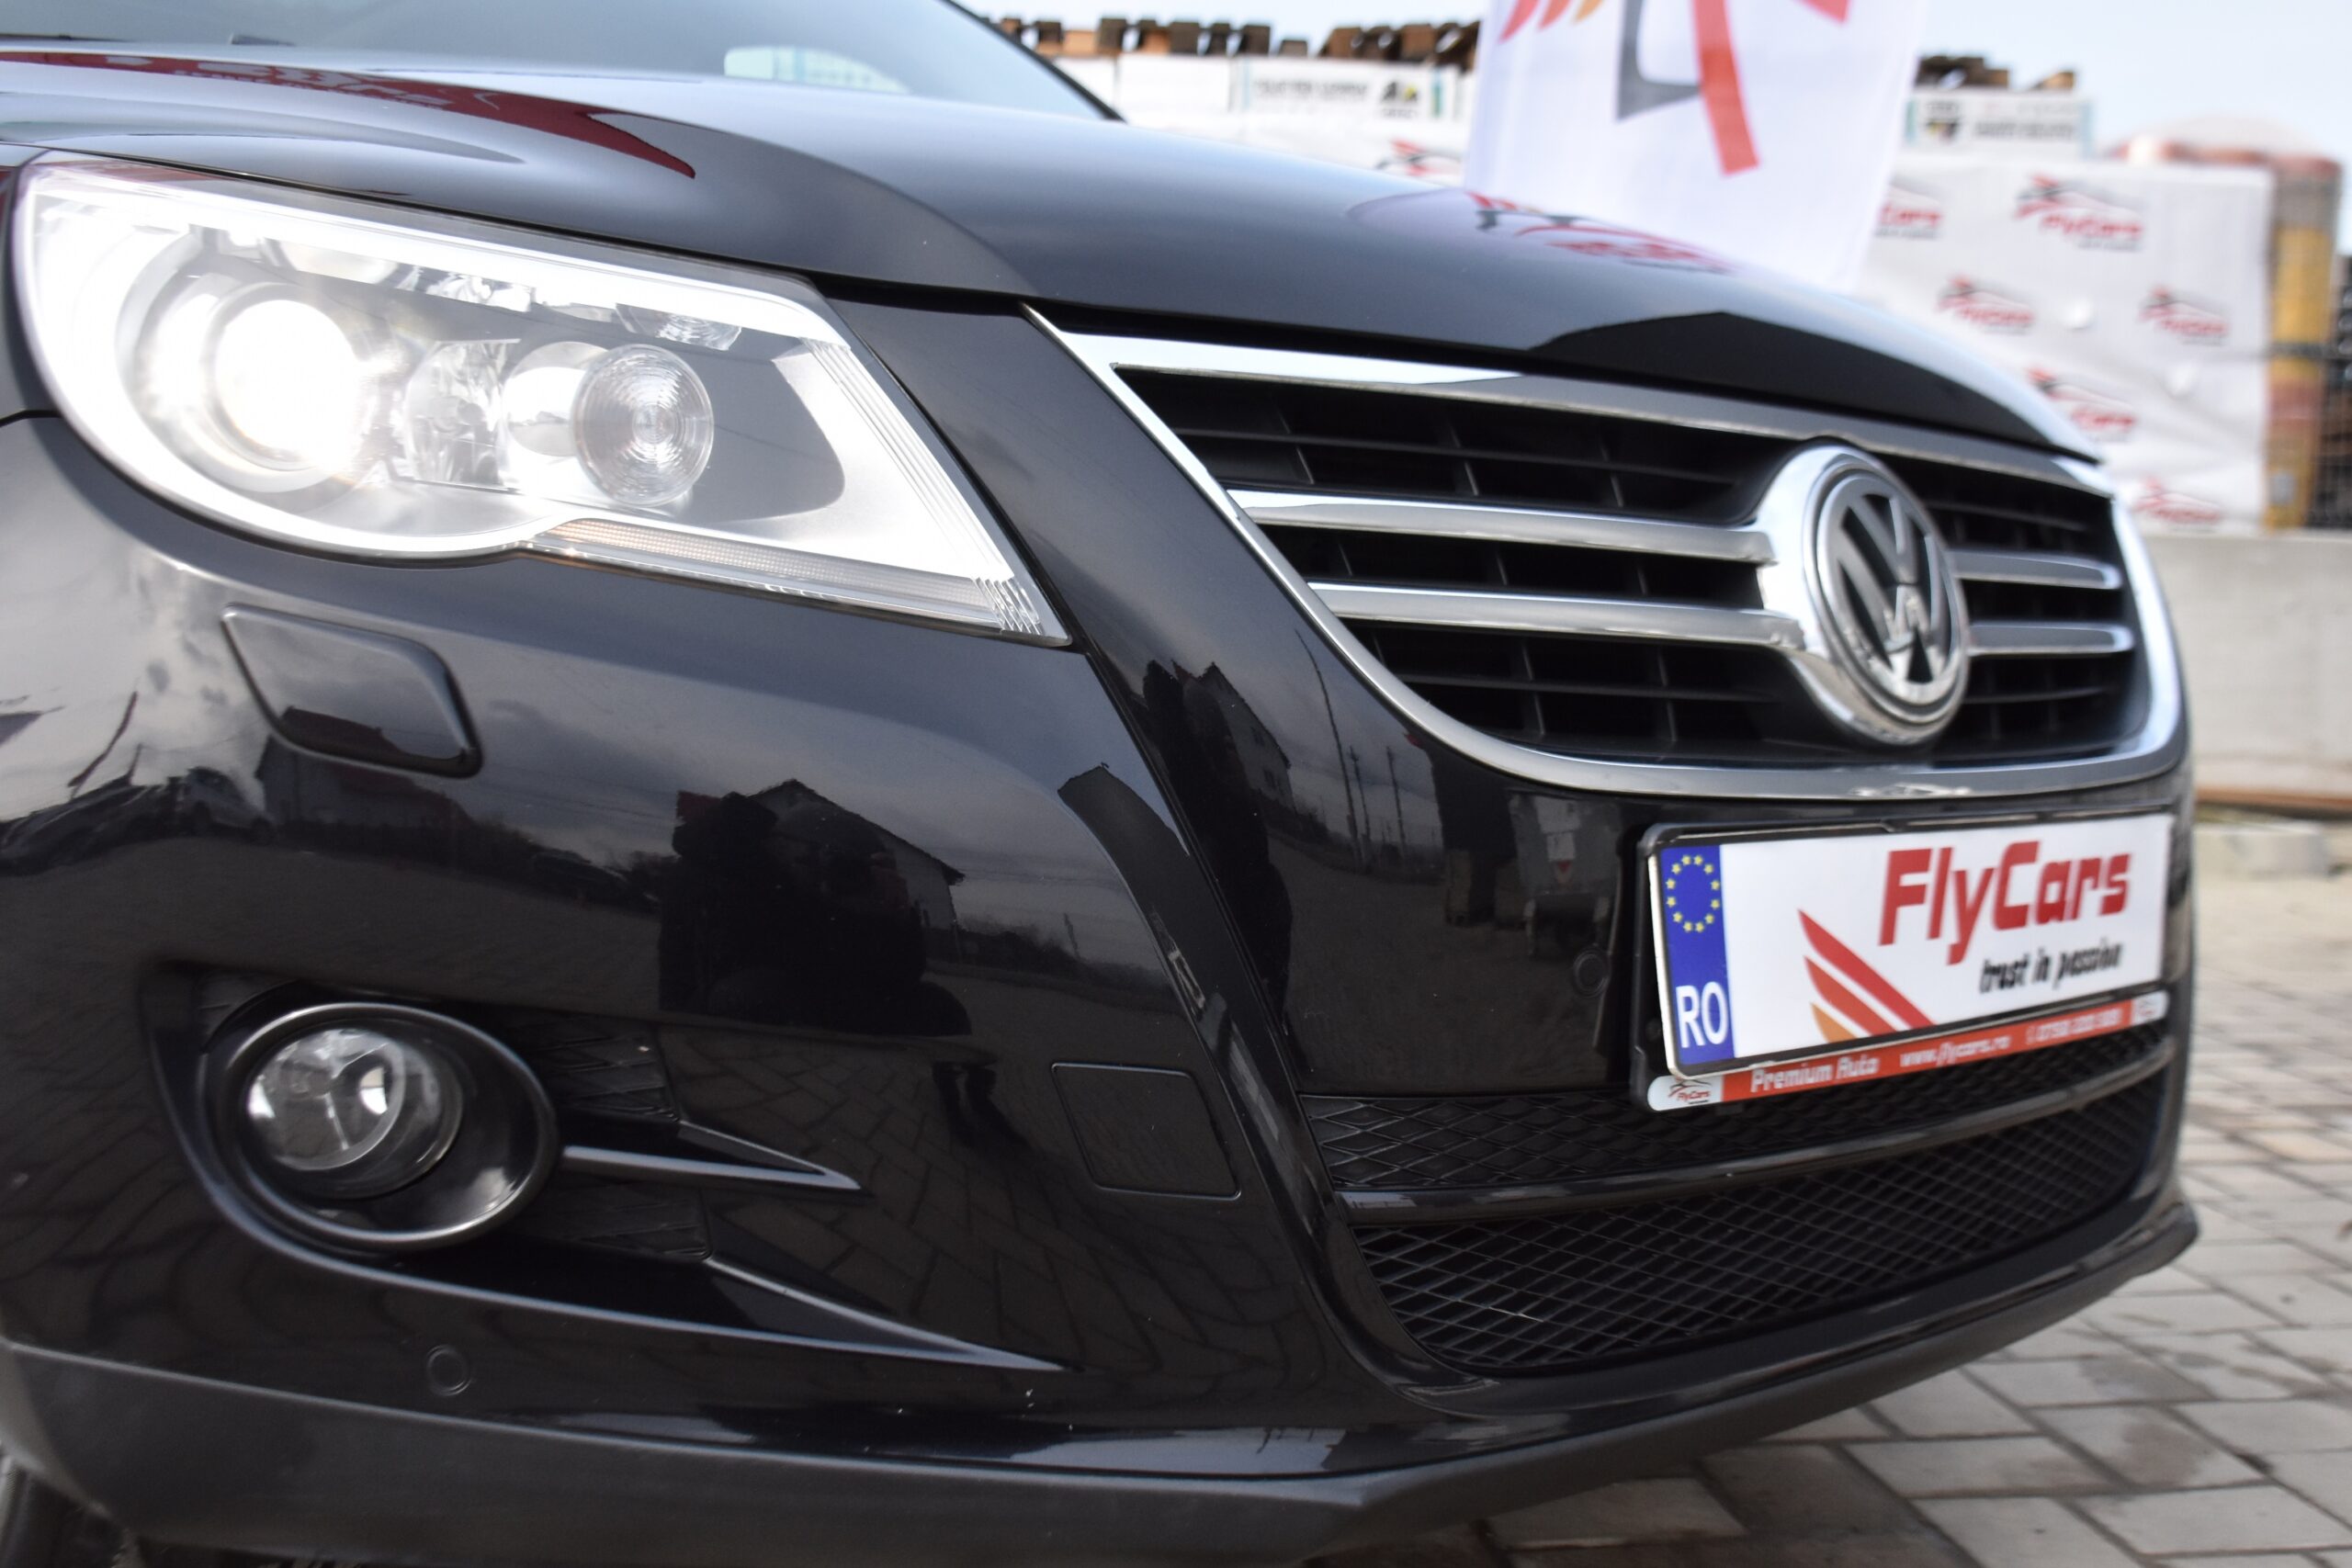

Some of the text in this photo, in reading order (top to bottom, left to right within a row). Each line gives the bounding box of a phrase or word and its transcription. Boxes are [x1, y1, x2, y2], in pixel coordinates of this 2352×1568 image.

[1877, 840, 2132, 965] FlyCars
[1675, 980, 1728, 1049] RO
[1751, 1062, 1833, 1092] Premium
[1837, 1055, 1880, 1080] Auto
